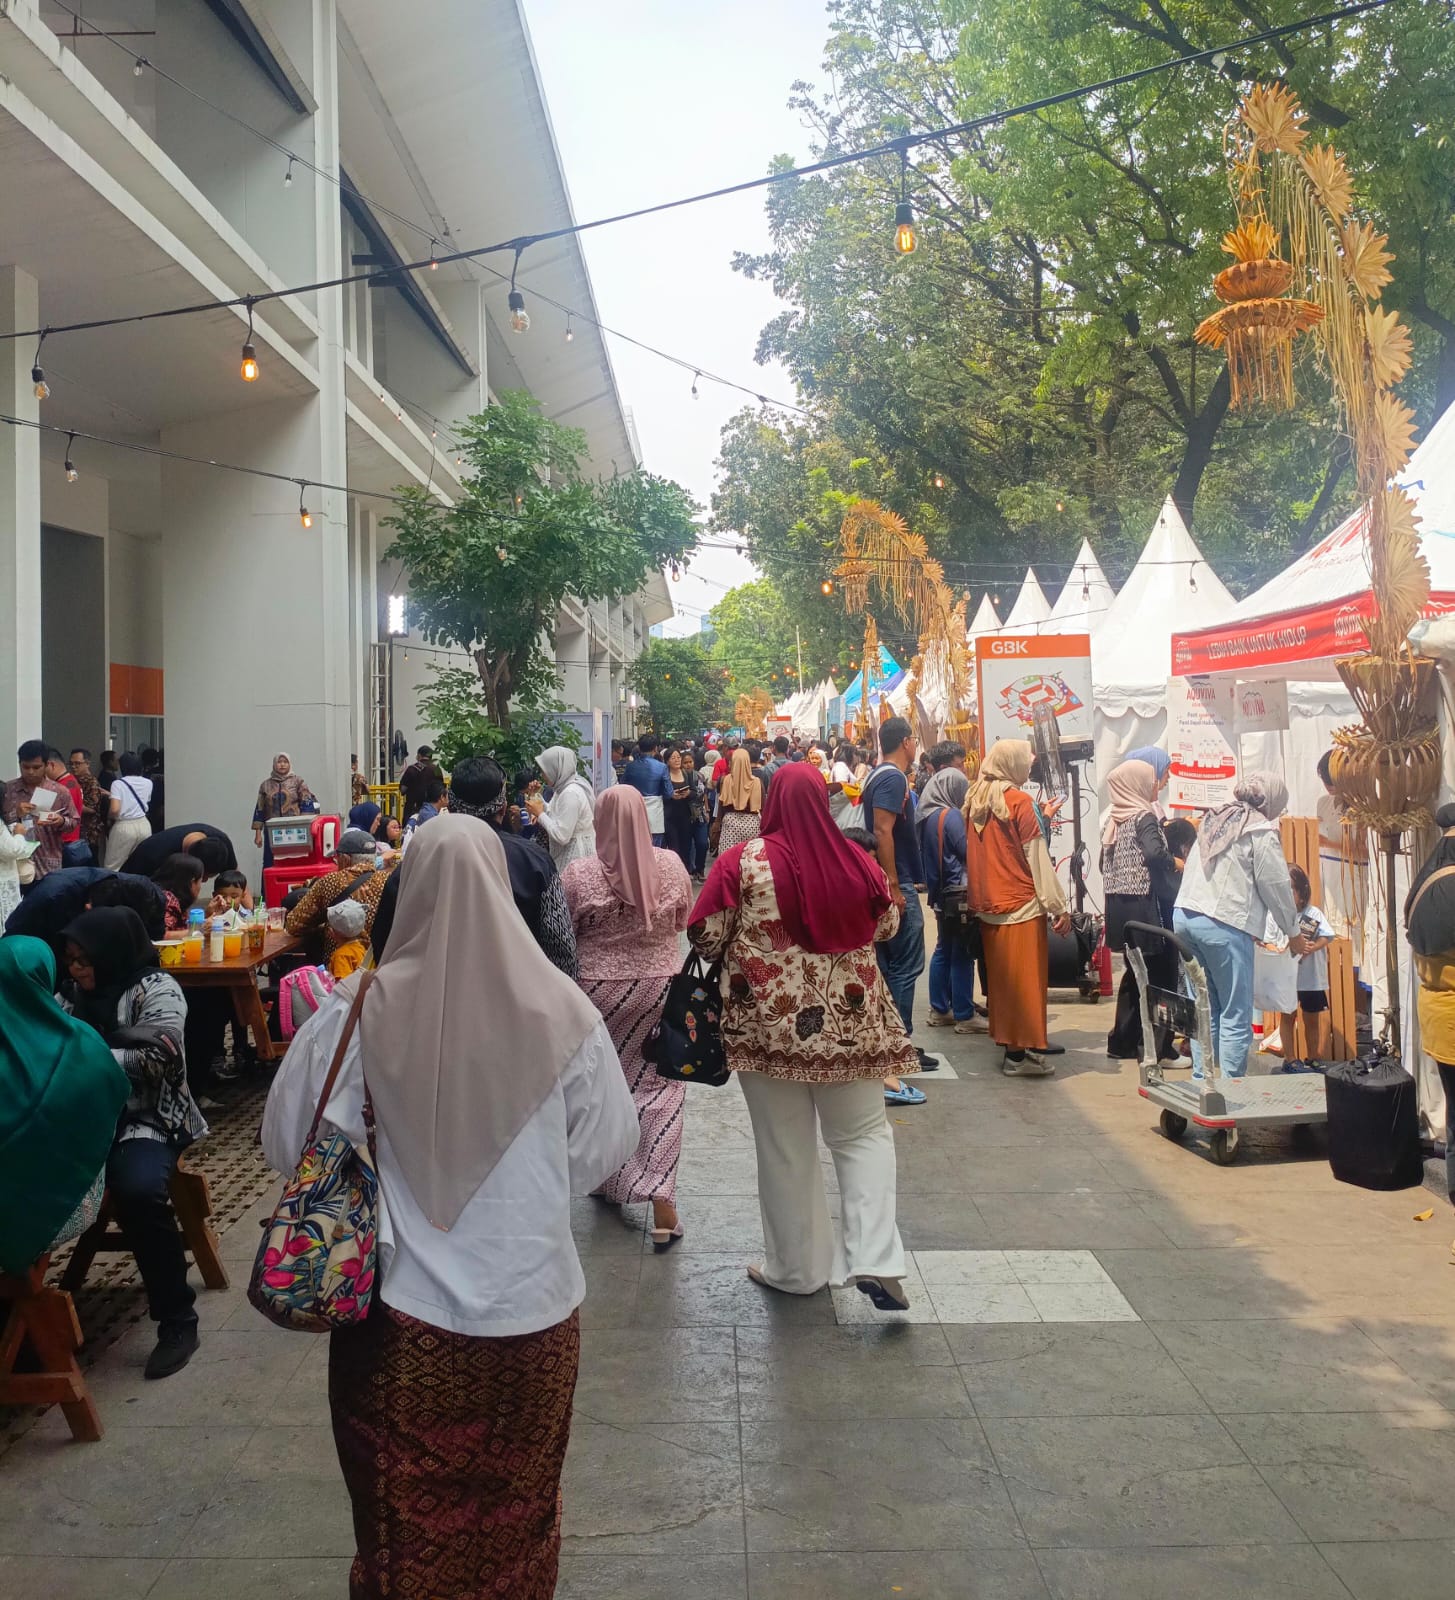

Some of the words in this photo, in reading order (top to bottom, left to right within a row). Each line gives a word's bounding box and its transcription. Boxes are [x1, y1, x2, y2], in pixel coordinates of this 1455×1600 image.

[991, 640, 1029, 655] GBK
[1206, 641, 1229, 660] LEBIH
[1228, 637, 1249, 657] BAIK
[1247, 632, 1278, 653] UNTUK
[1277, 625, 1307, 648] HIDUP
[1186, 688, 1216, 700] AQUVIVA
